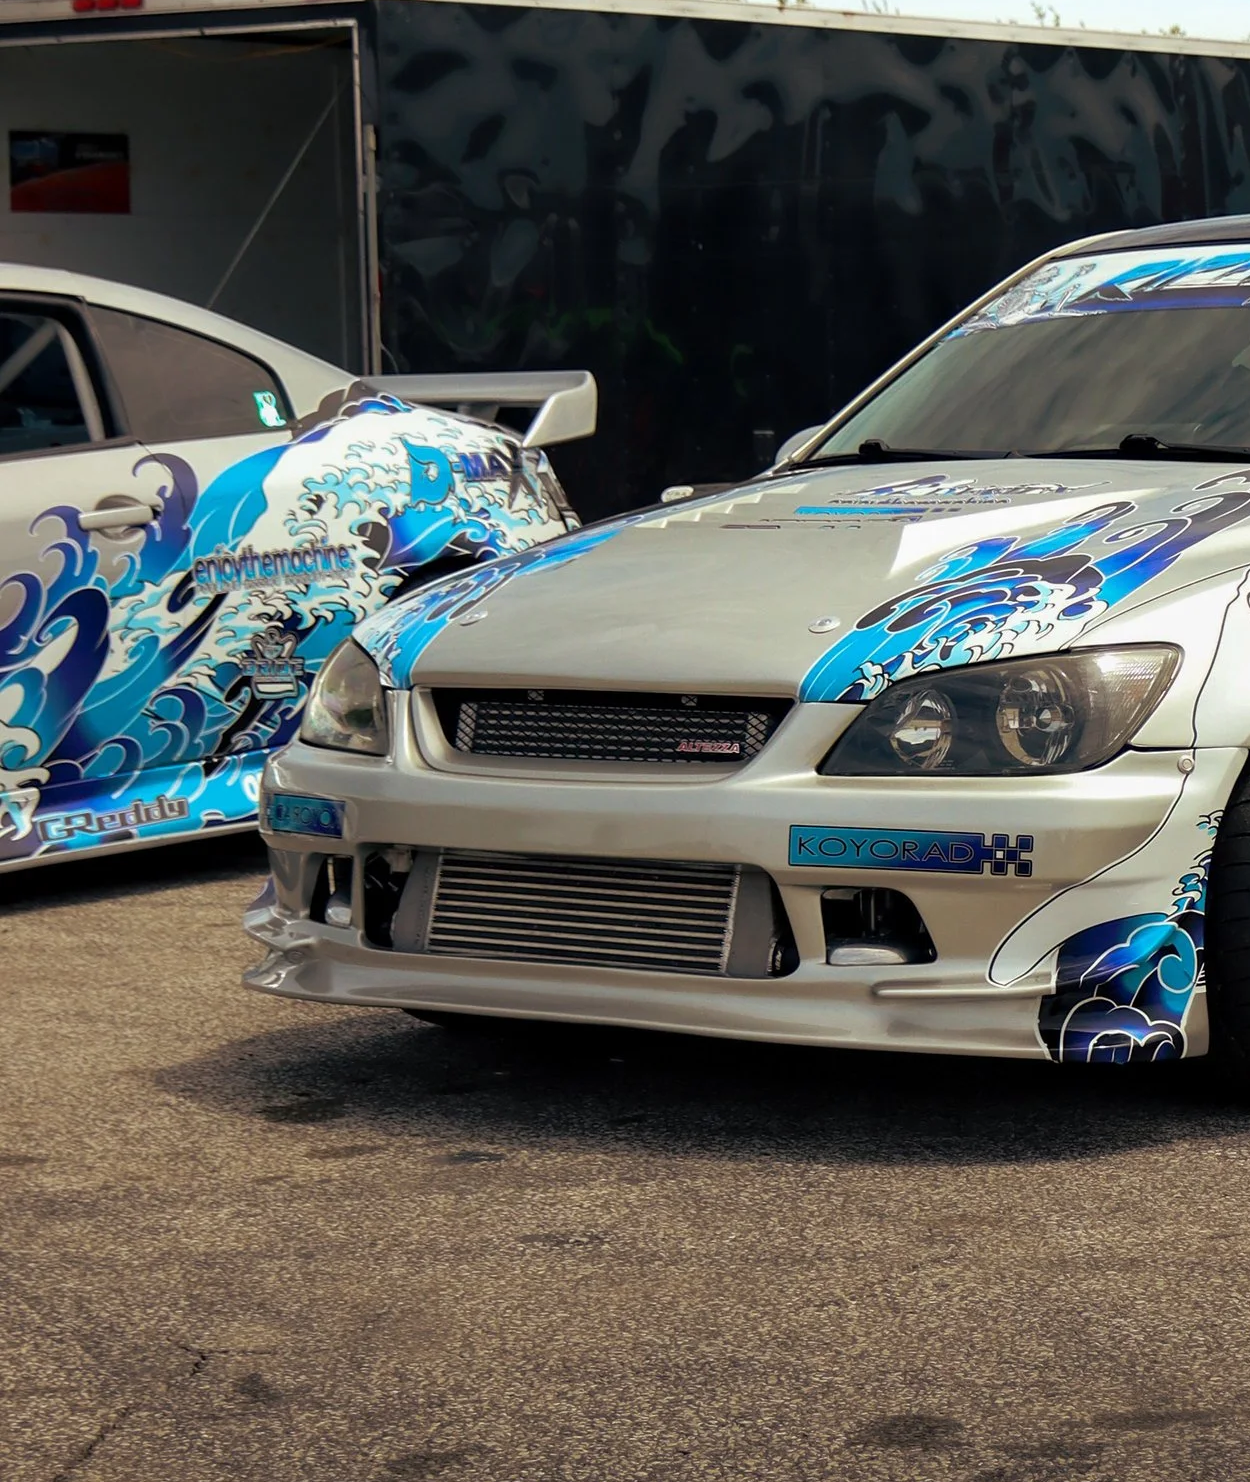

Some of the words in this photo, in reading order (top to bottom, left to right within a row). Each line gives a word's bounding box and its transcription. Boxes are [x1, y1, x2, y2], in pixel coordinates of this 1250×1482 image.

[676, 741, 740, 754] ALTEZZA
[37, 793, 190, 844] GReddy
[798, 835, 975, 864] KOYORAD
